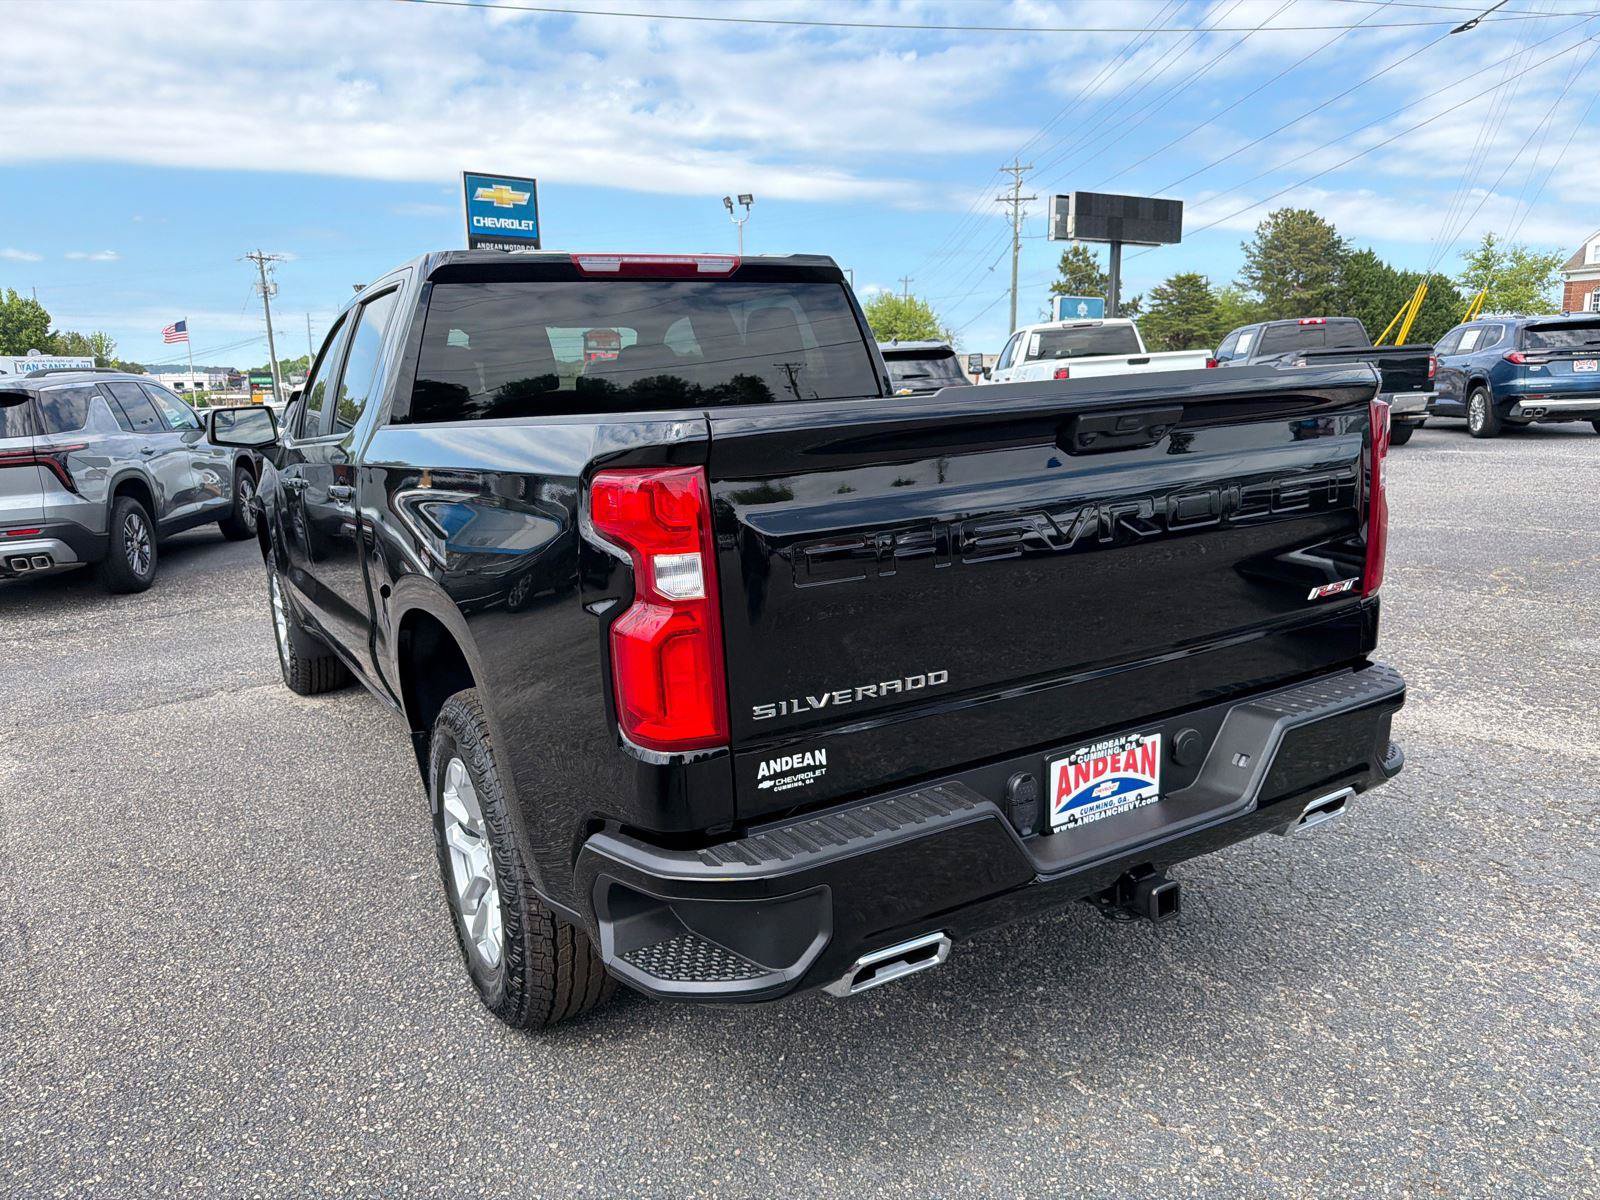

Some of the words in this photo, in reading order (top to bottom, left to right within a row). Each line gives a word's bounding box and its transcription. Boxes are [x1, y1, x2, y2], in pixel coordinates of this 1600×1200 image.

[473, 216, 534, 230] CHEVROLET
[477, 242, 502, 250] ANDEAN
[504, 243, 525, 251] MOTOR
[791, 473, 1358, 589] CHEVROLET
[1307, 577, 1359, 600] RST
[752, 670, 949, 721] SILVERADO
[1077, 746, 1122, 763] CUMMING,
[1124, 741, 1137, 750] GA
[1089, 737, 1126, 753] ANDEAN
[757, 749, 827, 779] ANDEAN
[1055, 740, 1157, 809] ANDEAN
[773, 781, 806, 792] CUMMING,
[805, 778, 815, 786] GA
[775, 768, 827, 786] CHEVROLET
[1053, 796, 1159, 833] www.ANDEANCHEVY.com
[1079, 800, 1116, 816] CUMMING,
